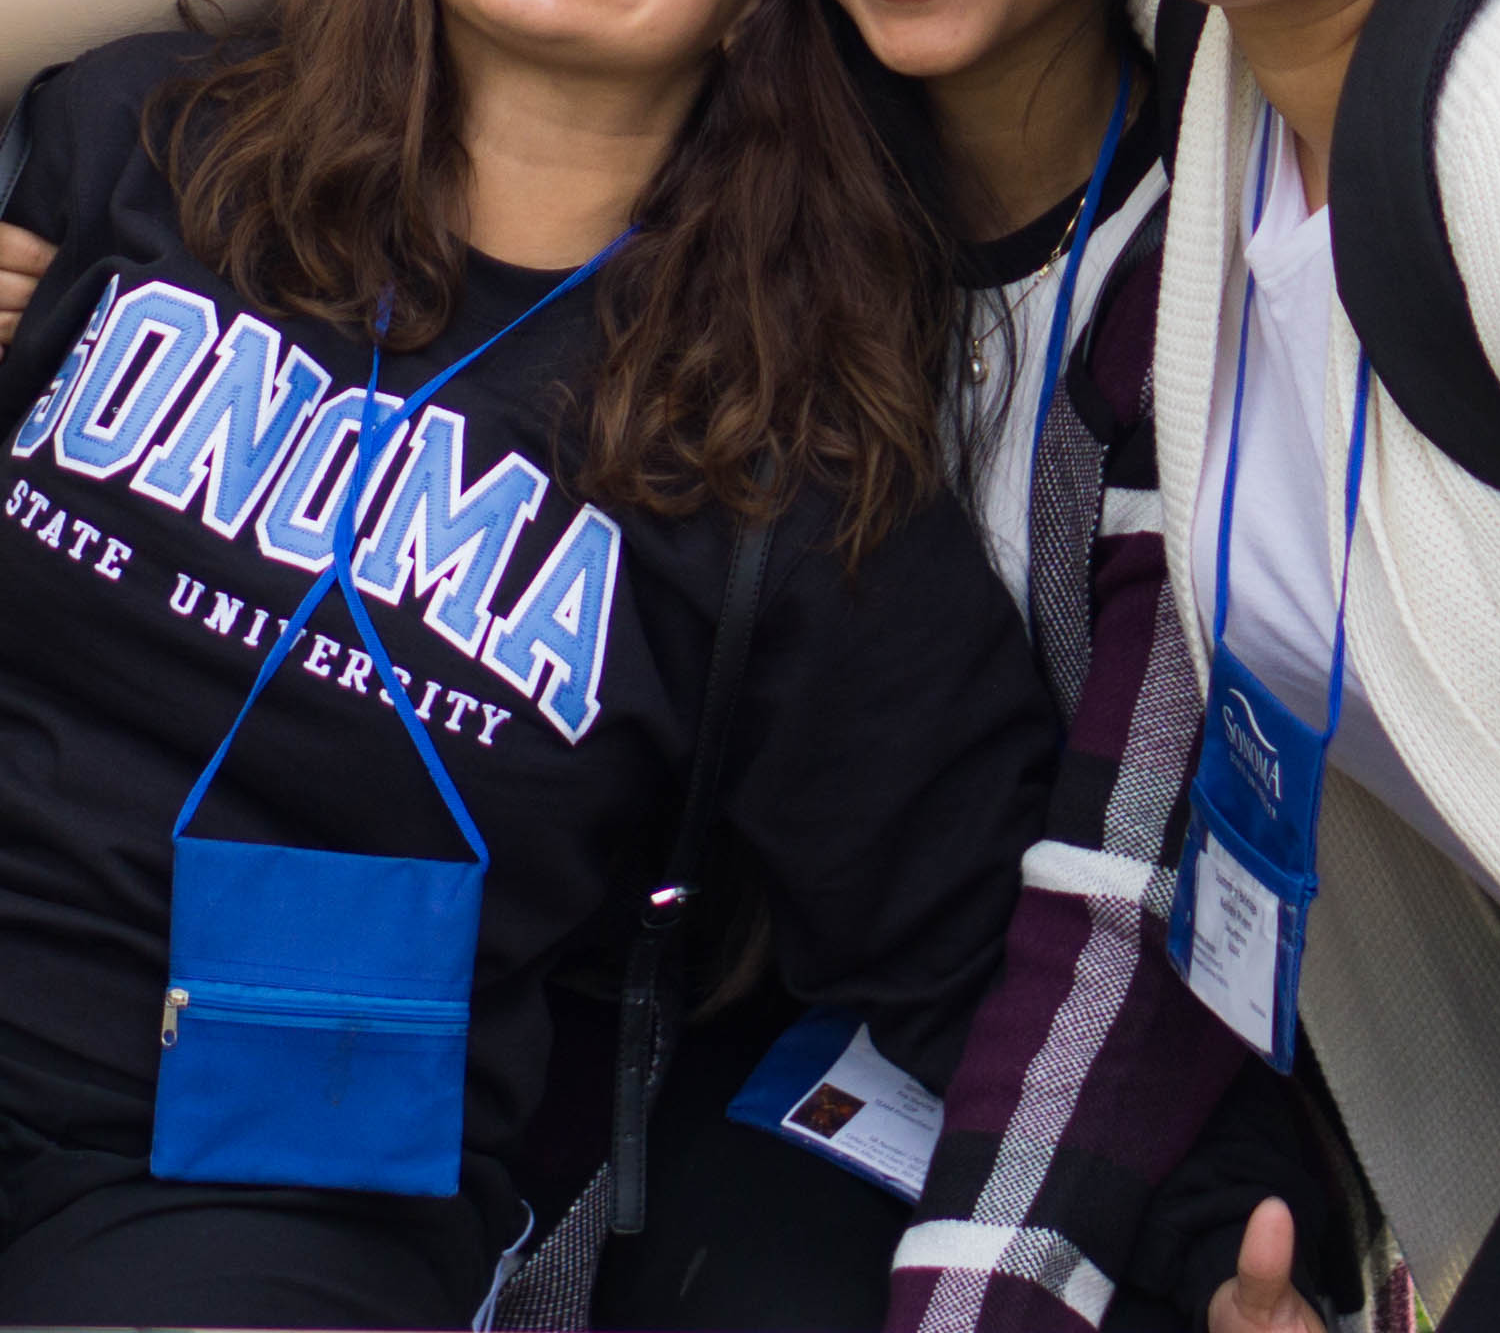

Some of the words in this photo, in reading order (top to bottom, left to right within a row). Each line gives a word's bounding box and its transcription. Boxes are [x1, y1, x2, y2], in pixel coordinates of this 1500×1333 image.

[4, 480, 133, 581] STATE
[11, 274, 621, 745] SONOMA
[1223, 705, 1281, 799] SONOMA
